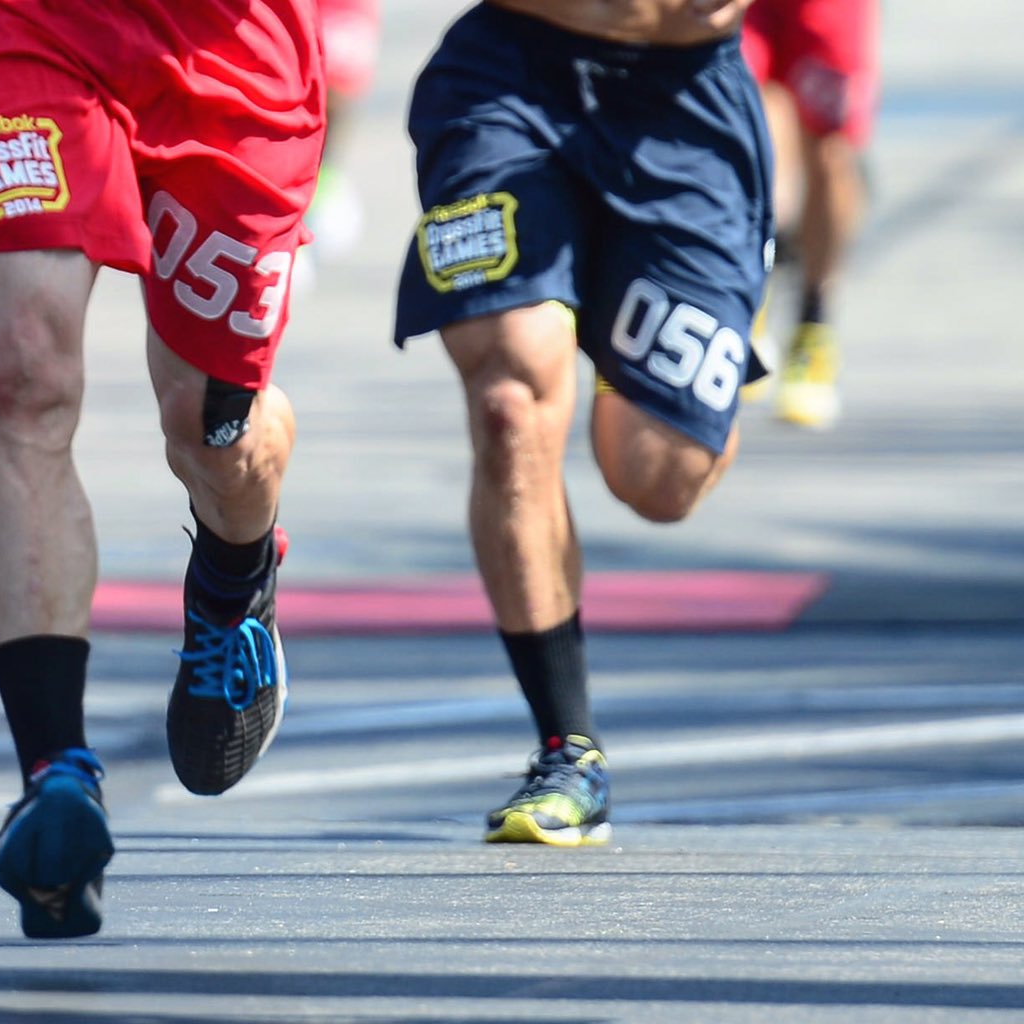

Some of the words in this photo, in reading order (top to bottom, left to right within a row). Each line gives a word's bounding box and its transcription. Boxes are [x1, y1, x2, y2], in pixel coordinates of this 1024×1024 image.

[3, 197, 44, 218] 2014
[148, 190, 292, 339] 053
[610, 277, 745, 413] 056
